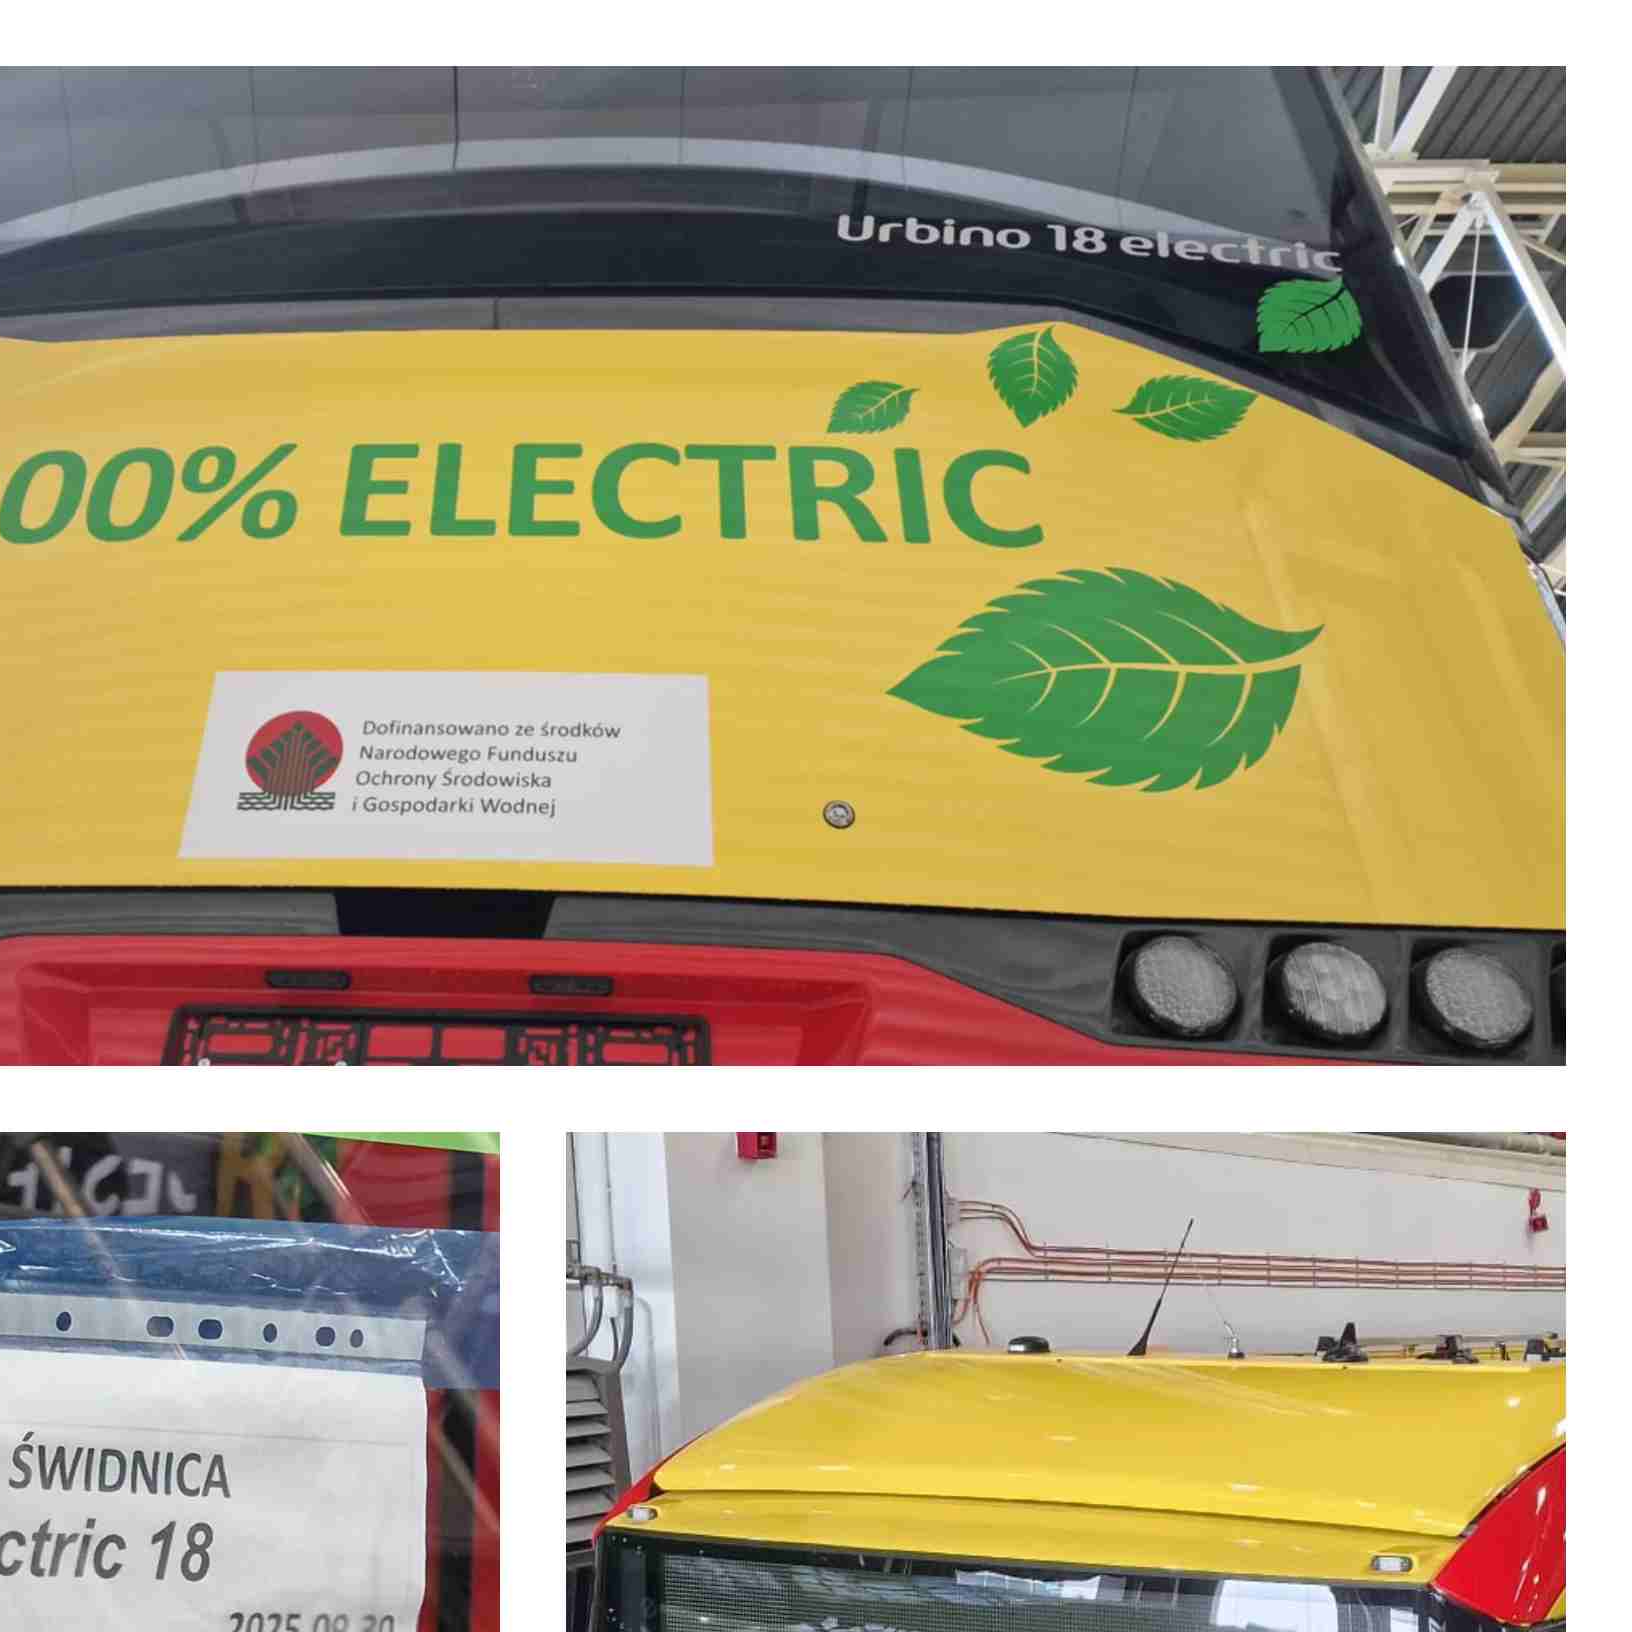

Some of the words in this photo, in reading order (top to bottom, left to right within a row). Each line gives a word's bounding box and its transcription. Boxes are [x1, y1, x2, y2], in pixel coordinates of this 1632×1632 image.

[837, 214, 1031, 250] Urbino
[1046, 223, 1108, 255] 18
[1119, 230, 1344, 273] electric
[338, 442, 1046, 548] ELECTRIC
[362, 719, 510, 737] Dofinansowano
[514, 725, 536, 737] ze
[540, 721, 622, 738] środków
[359, 744, 482, 764] Narodowego
[487, 745, 578, 763] Funduszu
[355, 769, 437, 790] Ochrony
[441, 767, 552, 788] Środowiska
[351, 796, 358, 812] i
[362, 796, 475, 816] Gospodarki
[480, 797, 557, 818] Wodnej
[8, 1431, 231, 1499] ŚWIDNICA
[150, 1520, 215, 1583] 18
